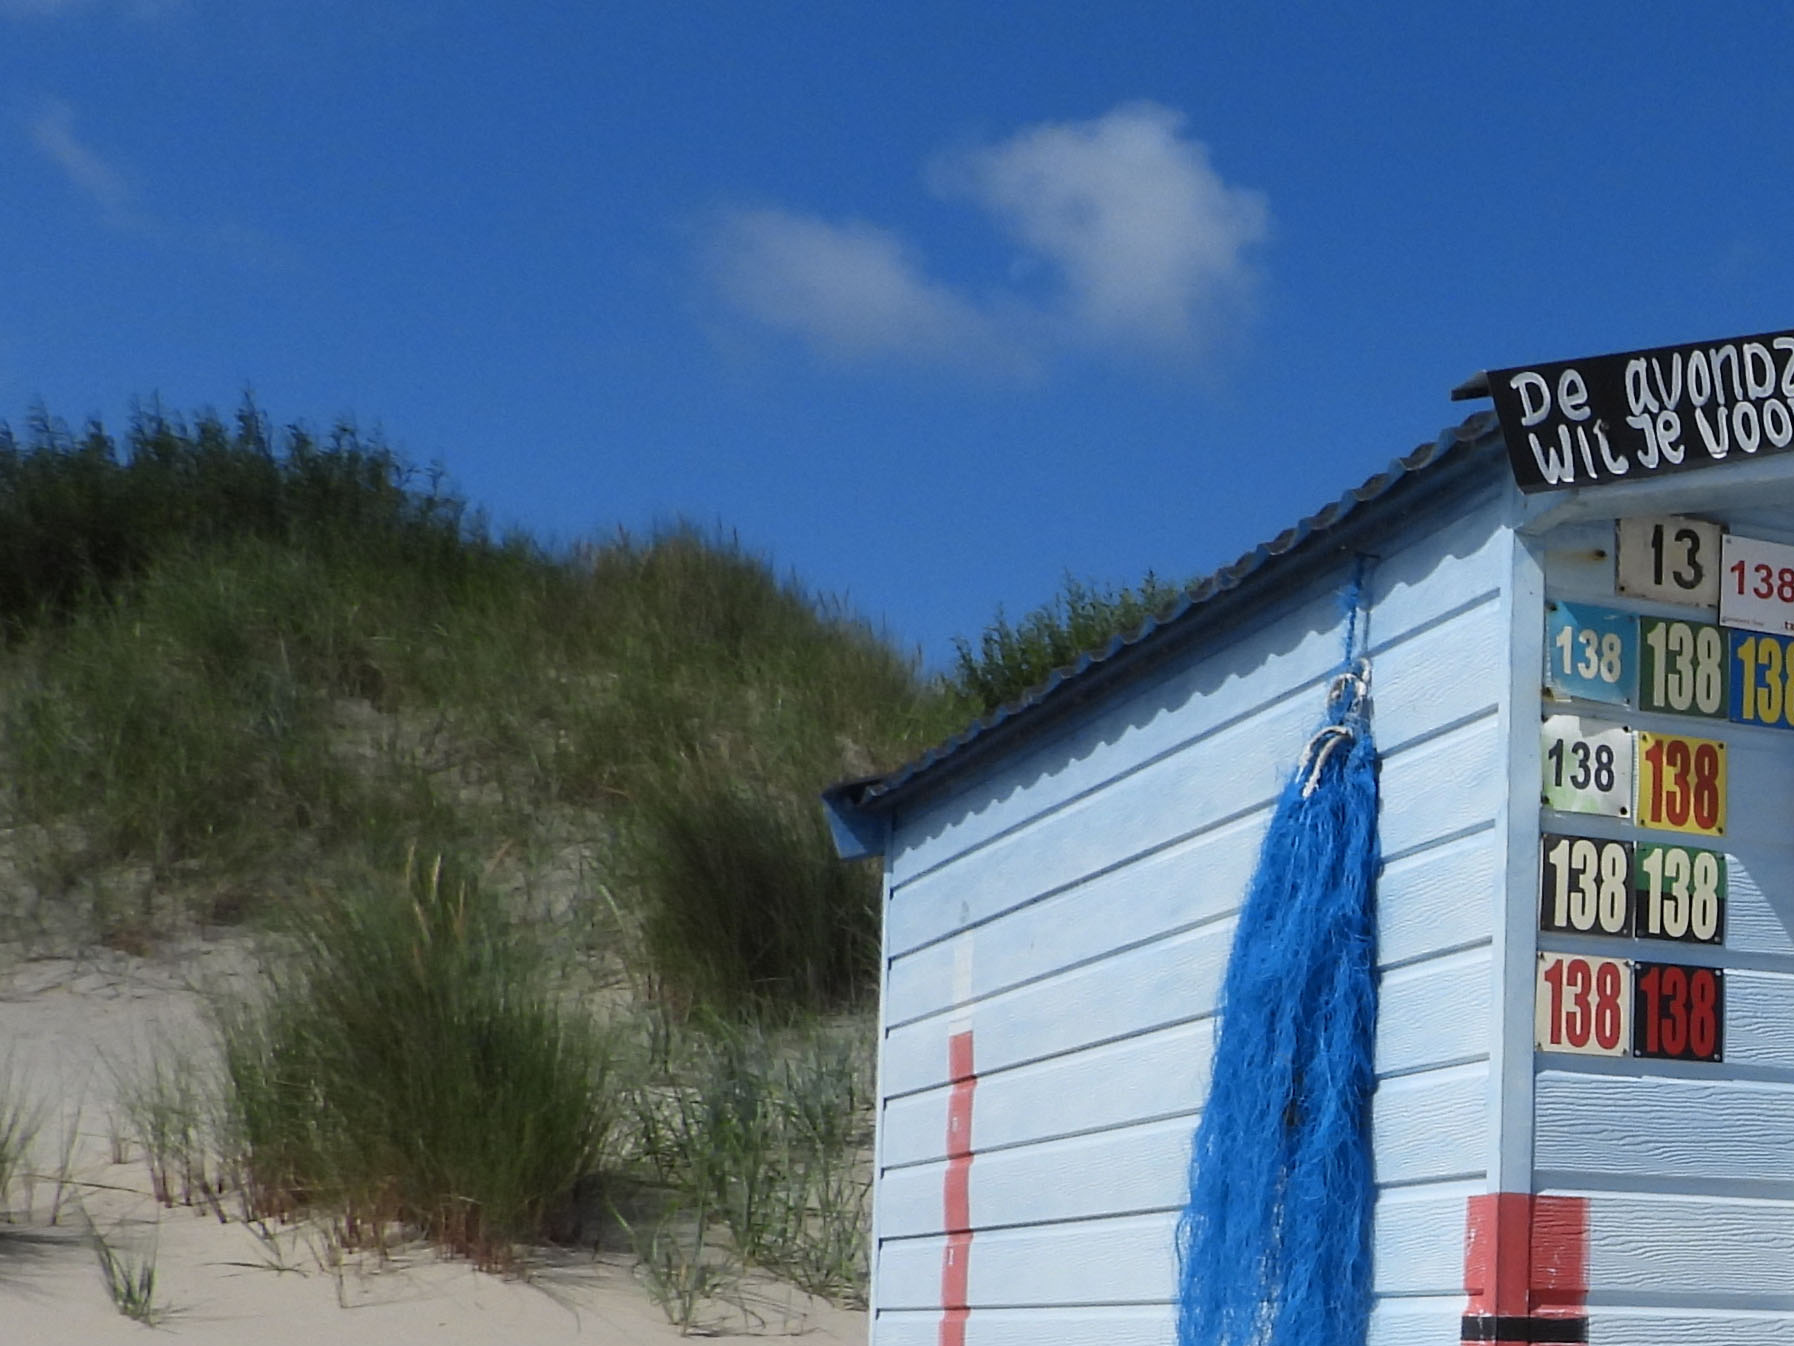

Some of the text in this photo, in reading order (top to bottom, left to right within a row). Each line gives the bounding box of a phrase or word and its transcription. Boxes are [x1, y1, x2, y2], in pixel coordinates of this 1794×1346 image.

[1510, 369, 1591, 426] De
[1651, 524, 1704, 590] 13
[1556, 626, 1622, 683] 138
[1647, 622, 1721, 713] 138
[1548, 738, 1614, 792] 138
[1645, 739, 1719, 829] 138
[1550, 839, 1627, 933] 138
[1643, 848, 1718, 940] 138
[1544, 959, 1621, 1049] 138
[1640, 967, 1716, 1057] 138
